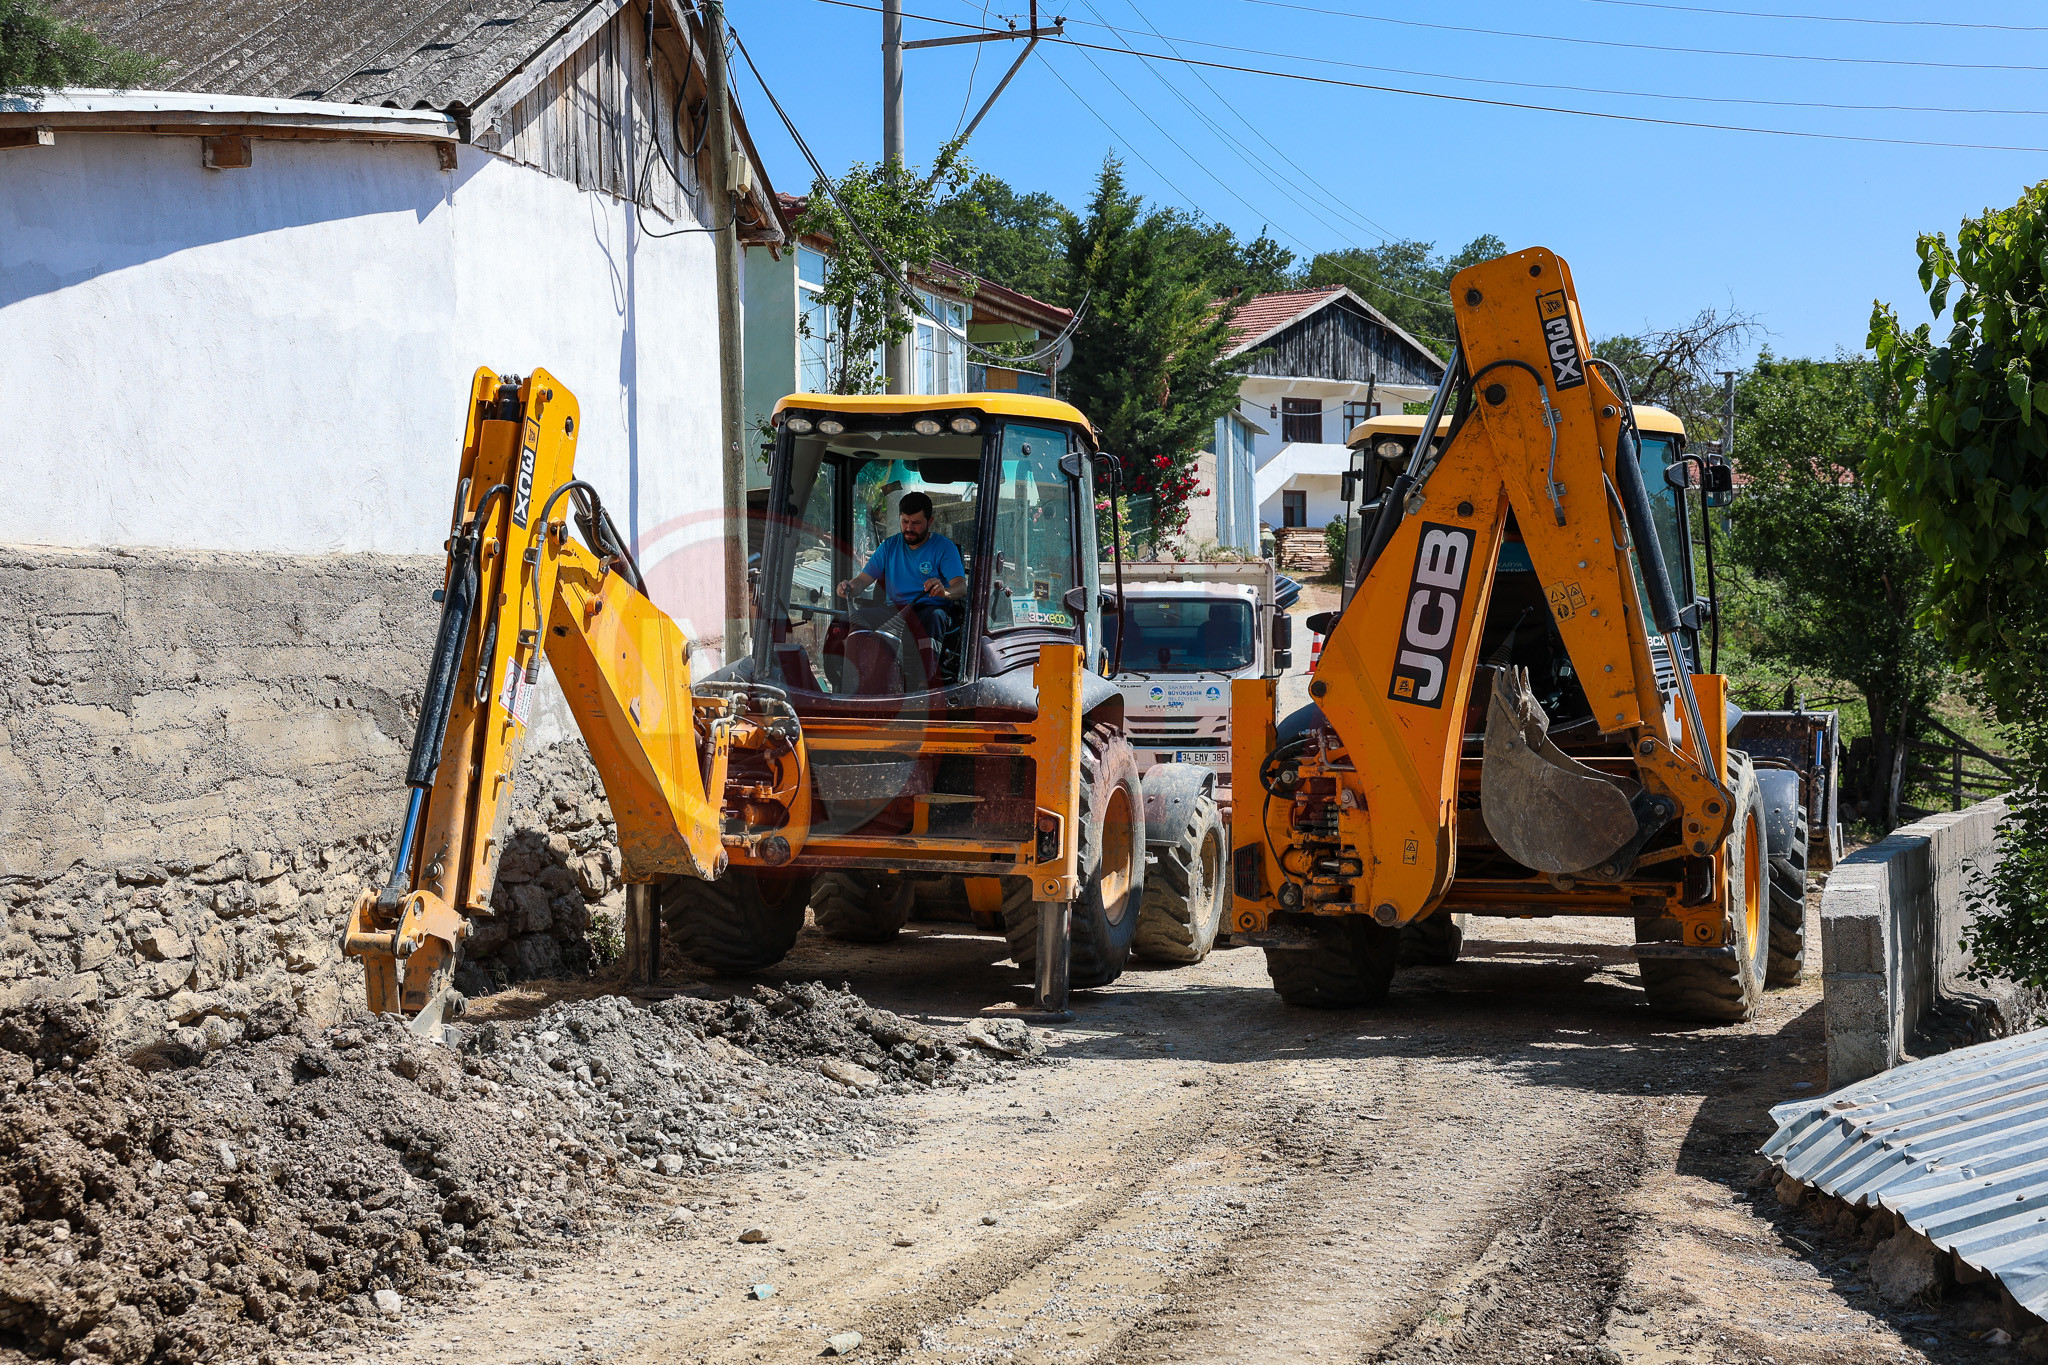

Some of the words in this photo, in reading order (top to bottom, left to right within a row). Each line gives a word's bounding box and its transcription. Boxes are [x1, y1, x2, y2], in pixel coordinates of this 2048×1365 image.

[1546, 318, 1582, 382] 3CX
[514, 448, 535, 520] 3CX
[1400, 529, 1469, 701] JCB
[1182, 753, 1191, 761] 34
[1194, 753, 1208, 761] EMV
[1212, 753, 1226, 761] 385
